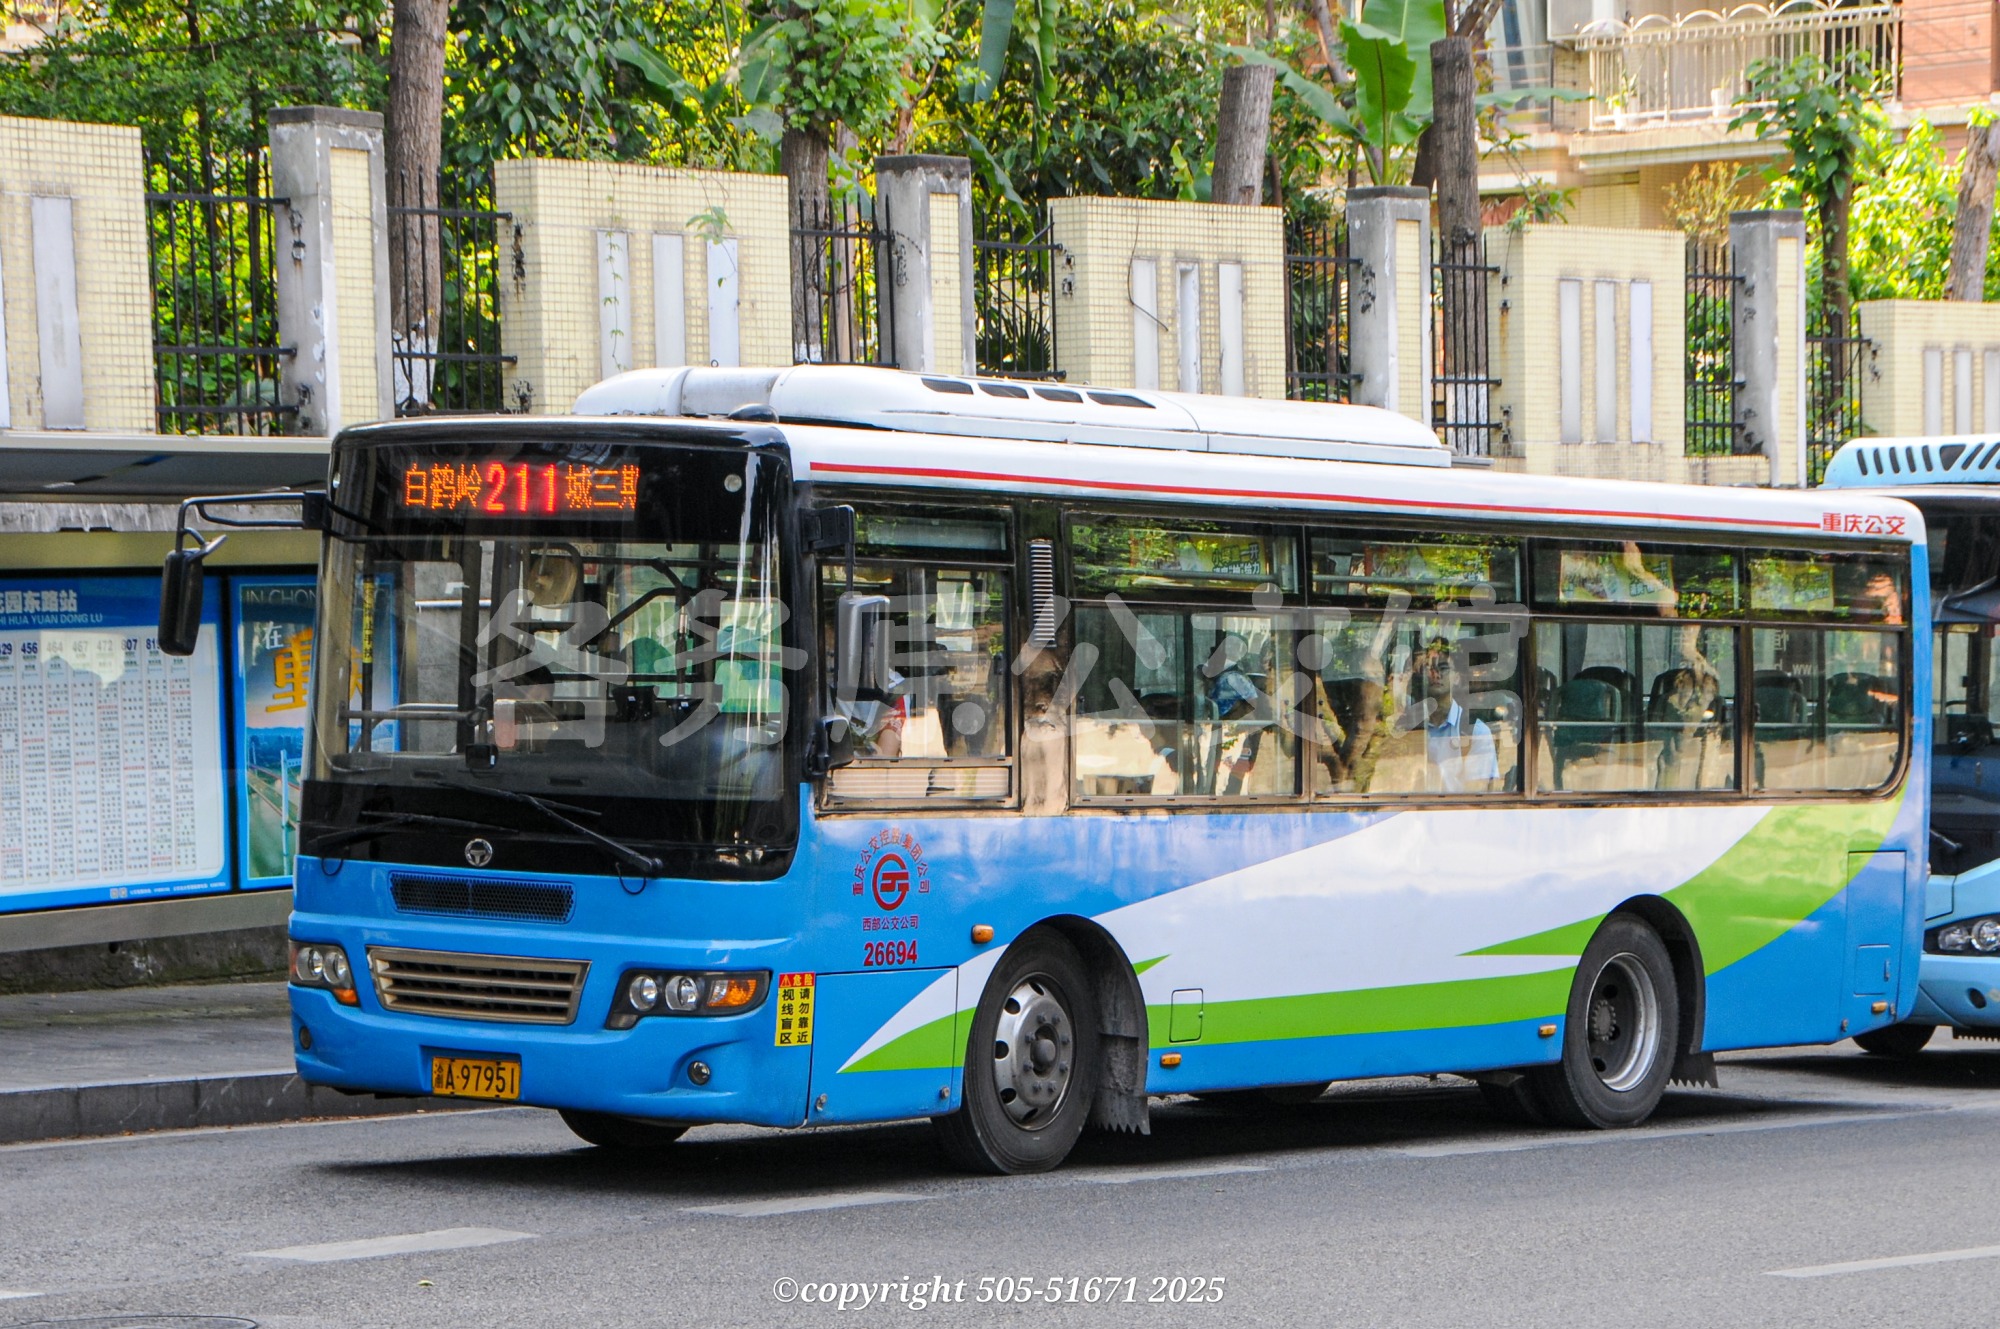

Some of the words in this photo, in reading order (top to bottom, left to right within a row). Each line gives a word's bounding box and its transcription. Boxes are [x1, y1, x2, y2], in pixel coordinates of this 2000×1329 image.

[406, 463, 482, 510] 白鹤岭
[485, 463, 556, 512] 211
[1822, 512, 1905, 535] 重庆公交
[0, 589, 78, 614] 园东路站
[9, 615, 29, 625] HUA
[31, 614, 58, 625] YUAN
[60, 613, 89, 624] DONG
[90, 612, 103, 623] LU
[0, 642, 13, 655] 29
[21, 641, 38, 654] 456
[72, 640, 89, 653] 467
[96, 639, 113, 651] 472
[121, 638, 138, 651] 807
[145, 638, 160, 650] 81
[262, 621, 284, 650] 在
[852, 827, 930, 896] 重庆公交控股集团公司
[862, 916, 918, 931] 西部公交公司
[863, 940, 918, 966] 26694
[793, 973, 813, 987] 危险
[780, 988, 795, 1045] 视线盲区
[796, 987, 811, 1044] 请勿靠近
